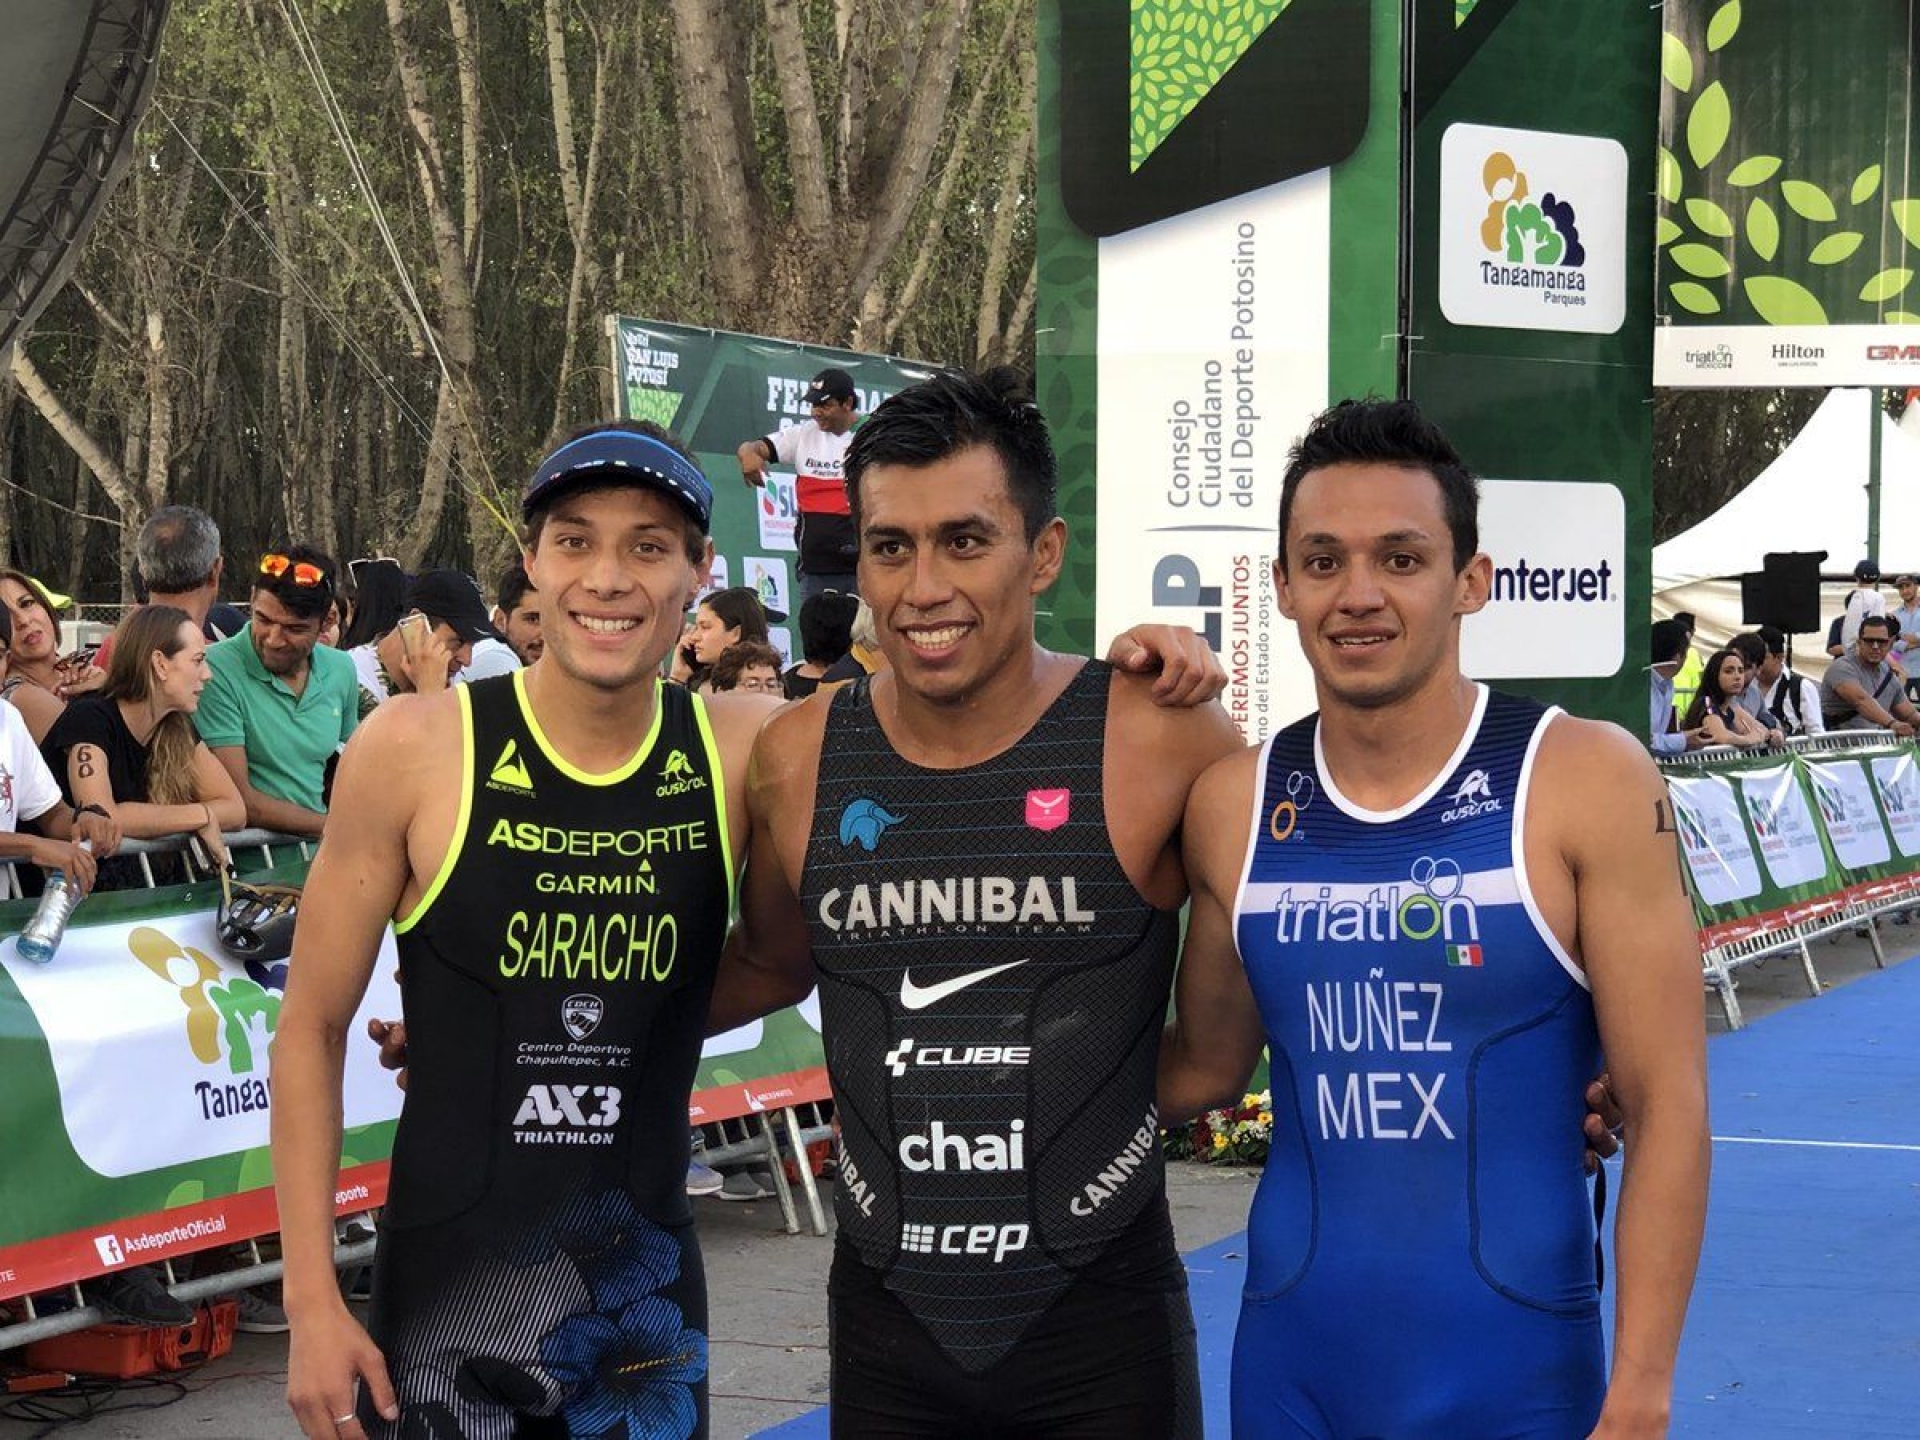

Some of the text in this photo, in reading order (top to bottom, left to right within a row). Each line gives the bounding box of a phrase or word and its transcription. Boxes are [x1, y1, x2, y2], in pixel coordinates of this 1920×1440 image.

[1480, 261, 1585, 291] Tangamanga
[1543, 291, 1586, 307] Parques
[653, 351, 679, 369] LUIS
[1229, 222, 1261, 507] del Deporte Potosino
[1772, 343, 1825, 359] Hilton
[1867, 345, 1920, 360] GM
[1198, 360, 1222, 507] Ciudadano
[1167, 400, 1197, 507] Consejo
[1232, 554, 1250, 636] JUNTOS
[1258, 554, 1273, 628] 2015-2021
[1256, 633, 1270, 685] Estado
[1254, 689, 1269, 713] del
[488, 818, 708, 857] ASDEPORTE
[536, 873, 656, 895] GARMIN
[819, 876, 1095, 932] CANNIBAL
[500, 911, 678, 981] SARACHO
[836, 924, 1091, 941] TRIATHLON TEAM
[1306, 967, 1452, 1052] NUÑEZ
[518, 1042, 631, 1055] Centro Deportivo
[607, 1057, 631, 1068] A.C.
[915, 1046, 1031, 1065] CUBE
[194, 1078, 270, 1120] Tanga
[512, 1084, 622, 1127] AX3
[1317, 1073, 1455, 1140] MEX
[513, 1131, 615, 1145] TRIATHLON
[899, 1119, 1025, 1171] chai
[124, 1215, 226, 1254] AsdeporteOficial
[940, 1224, 1030, 1263] cep
